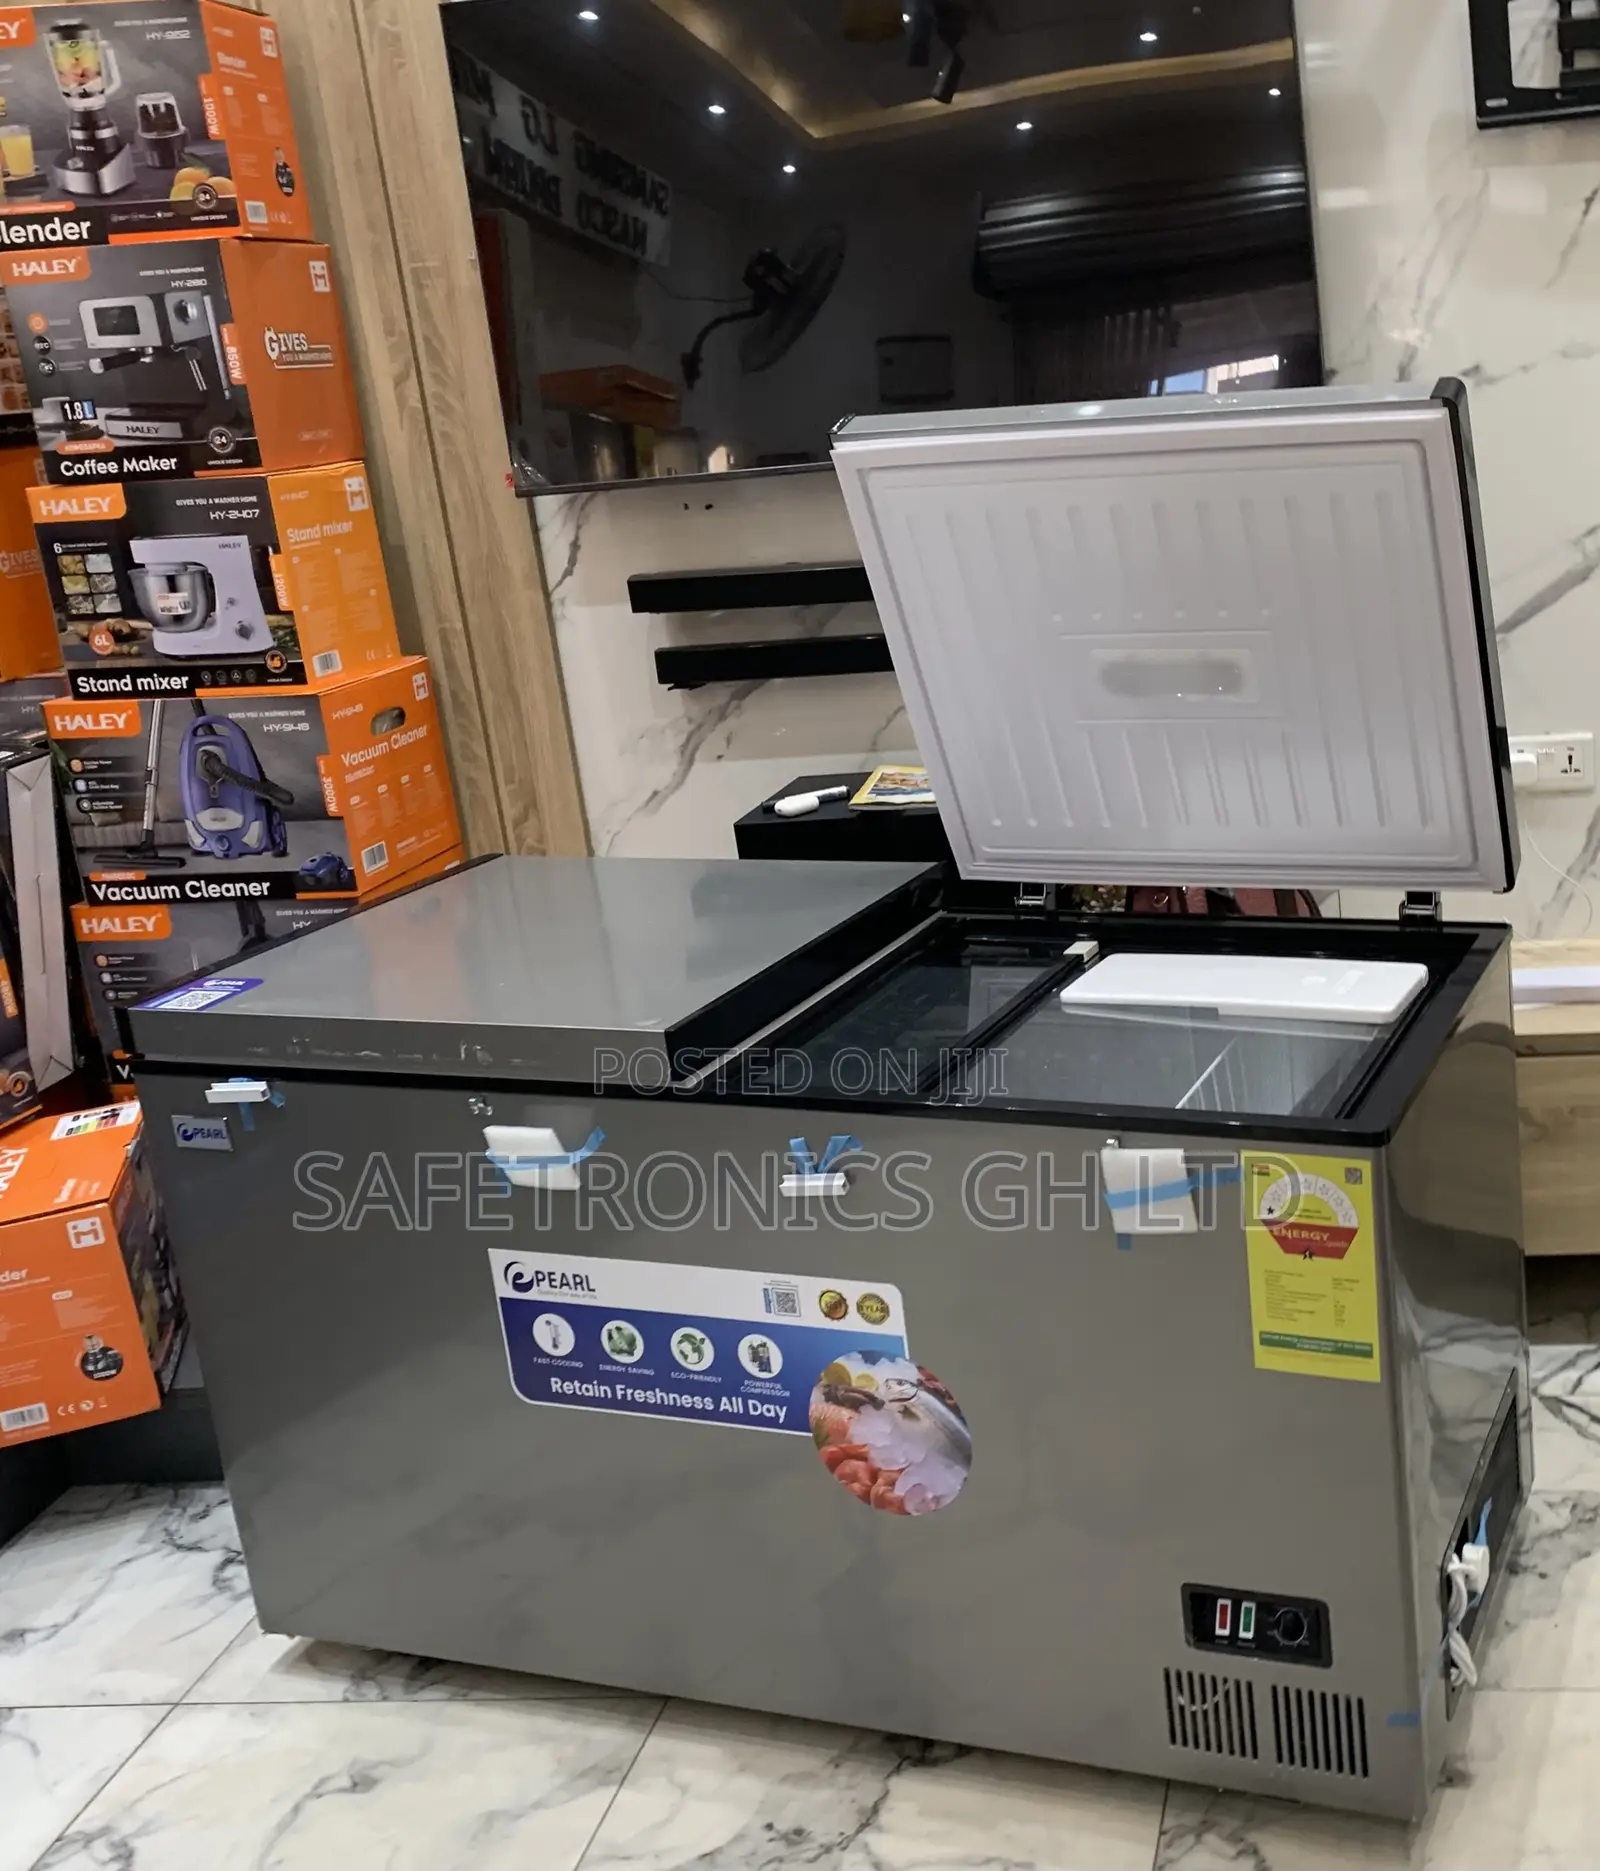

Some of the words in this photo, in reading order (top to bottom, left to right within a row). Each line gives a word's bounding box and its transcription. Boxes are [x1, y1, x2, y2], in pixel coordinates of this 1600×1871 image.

[204, 97, 220, 135] 1000W
[0, 219, 92, 245] lender
[12, 258, 78, 278] HALEY
[264, 327, 308, 360] GIVES
[63, 400, 94, 420] 1.8L
[126, 425, 160, 434] HALEY
[60, 458, 119, 477] Coffee
[123, 455, 178, 473] Maker
[39, 497, 111, 516] HALEY
[209, 509, 260, 520] HY-2407
[286, 525, 322, 543] Stand
[322, 520, 354, 538] mixer
[53, 542, 62, 554] 6
[94, 634, 110, 646] 6L
[76, 674, 133, 693] Stand
[136, 673, 189, 691] mixer
[53, 712, 128, 732] HALEY
[263, 722, 310, 732] HY-948
[340, 741, 390, 768] Vacuum
[390, 724, 428, 751] Cleaner
[322, 776, 339, 812] 3000W
[91, 881, 181, 901] Vacuum
[185, 880, 270, 898] Cleaner
[81, 915, 157, 935] HALEY
[1272, 1227, 1330, 1241] ENERGY
[534, 1270, 596, 1293] PEARL
[599, 1363, 626, 1373] ENERGY
[627, 1366, 655, 1377] SAVING
[670, 1371, 722, 1384] ECO-FRIENDLY
[740, 1386, 791, 1397] COMPRESSOR
[744, 1379, 783, 1390] POWERFUL
[550, 1377, 612, 1398] Retain
[616, 1384, 714, 1411] Freshness
[719, 1396, 744, 1414] All
[747, 1400, 788, 1424] Day
